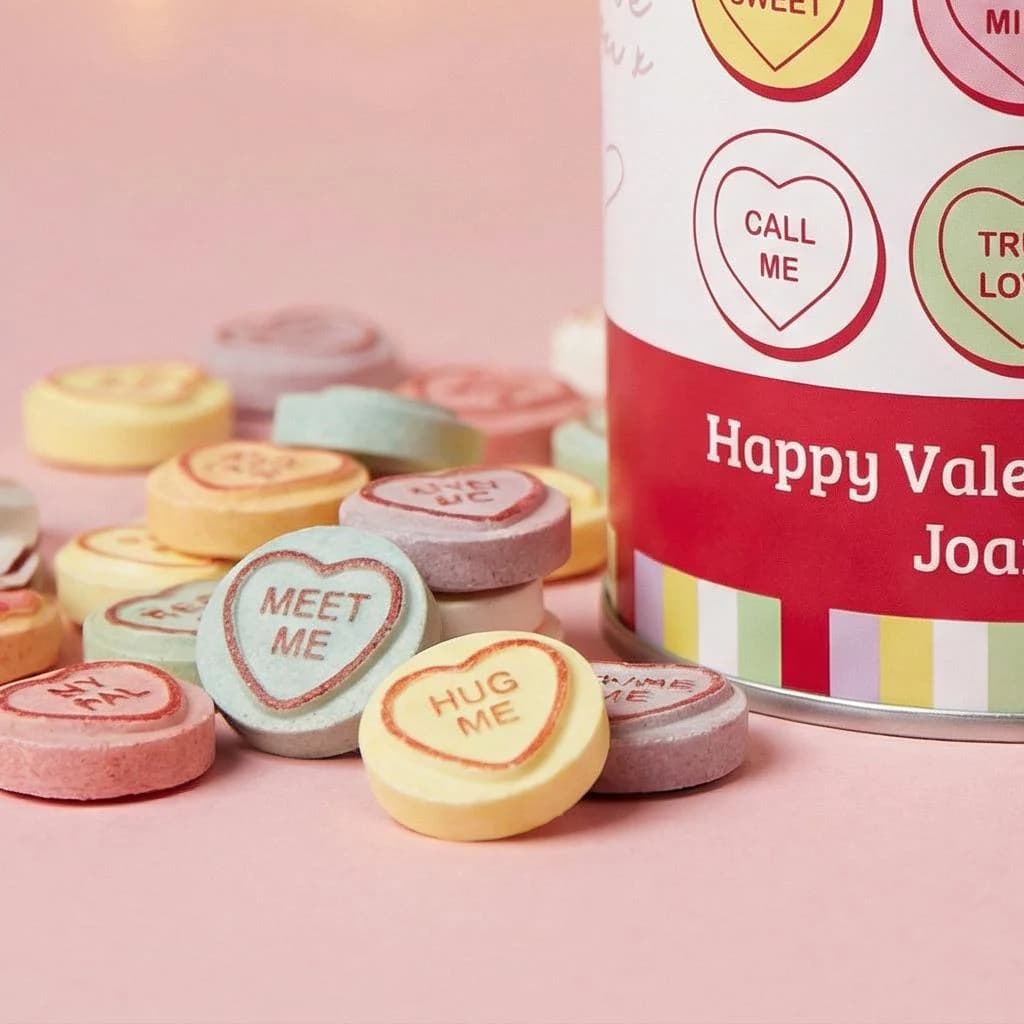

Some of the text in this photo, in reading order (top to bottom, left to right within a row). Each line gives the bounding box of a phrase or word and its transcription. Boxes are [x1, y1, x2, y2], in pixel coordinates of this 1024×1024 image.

[744, 209, 816, 245] CALL
[760, 252, 799, 283] ME
[706, 412, 879, 503] Happy
[259, 586, 372, 624] MEET
[270, 627, 333, 662] ME
[428, 670, 520, 718] HUG
[456, 701, 521, 737] ME
